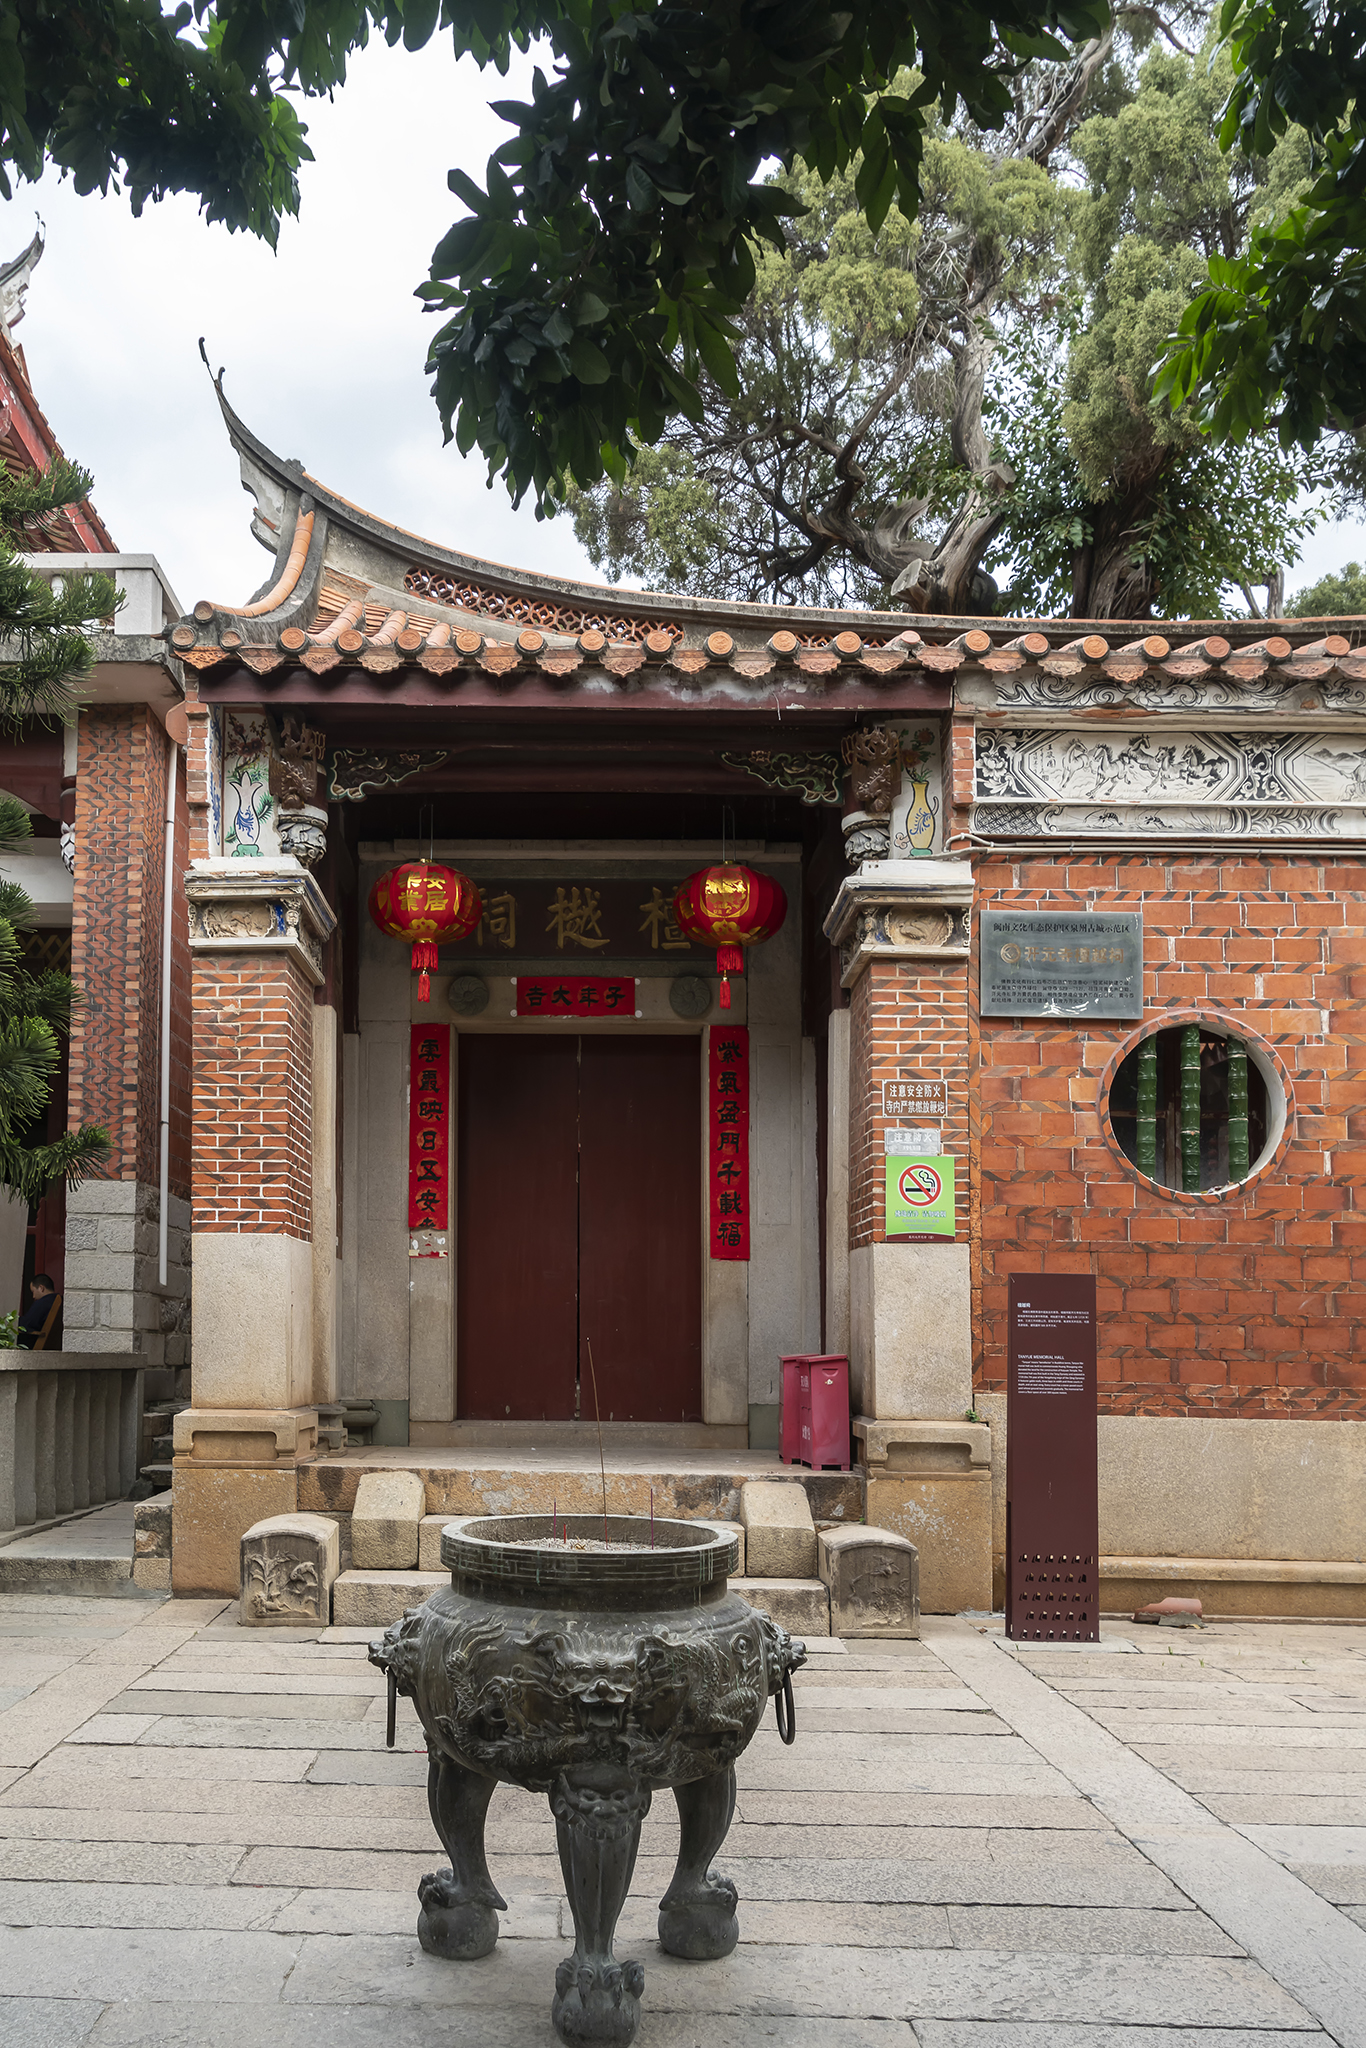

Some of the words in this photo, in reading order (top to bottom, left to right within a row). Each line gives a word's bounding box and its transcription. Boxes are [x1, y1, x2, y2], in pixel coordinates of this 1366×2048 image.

[423, 871, 448, 912] 安居
[993, 922, 1131, 934] 闽南文化生态保护区泉州古城示范区
[525, 984, 626, 1009] 子年大吉
[889, 1084, 941, 1098] 注意安全防火
[886, 1100, 945, 1114] 寺内严禁燃放鞭炮
[894, 1132, 932, 1143] 注意防火
